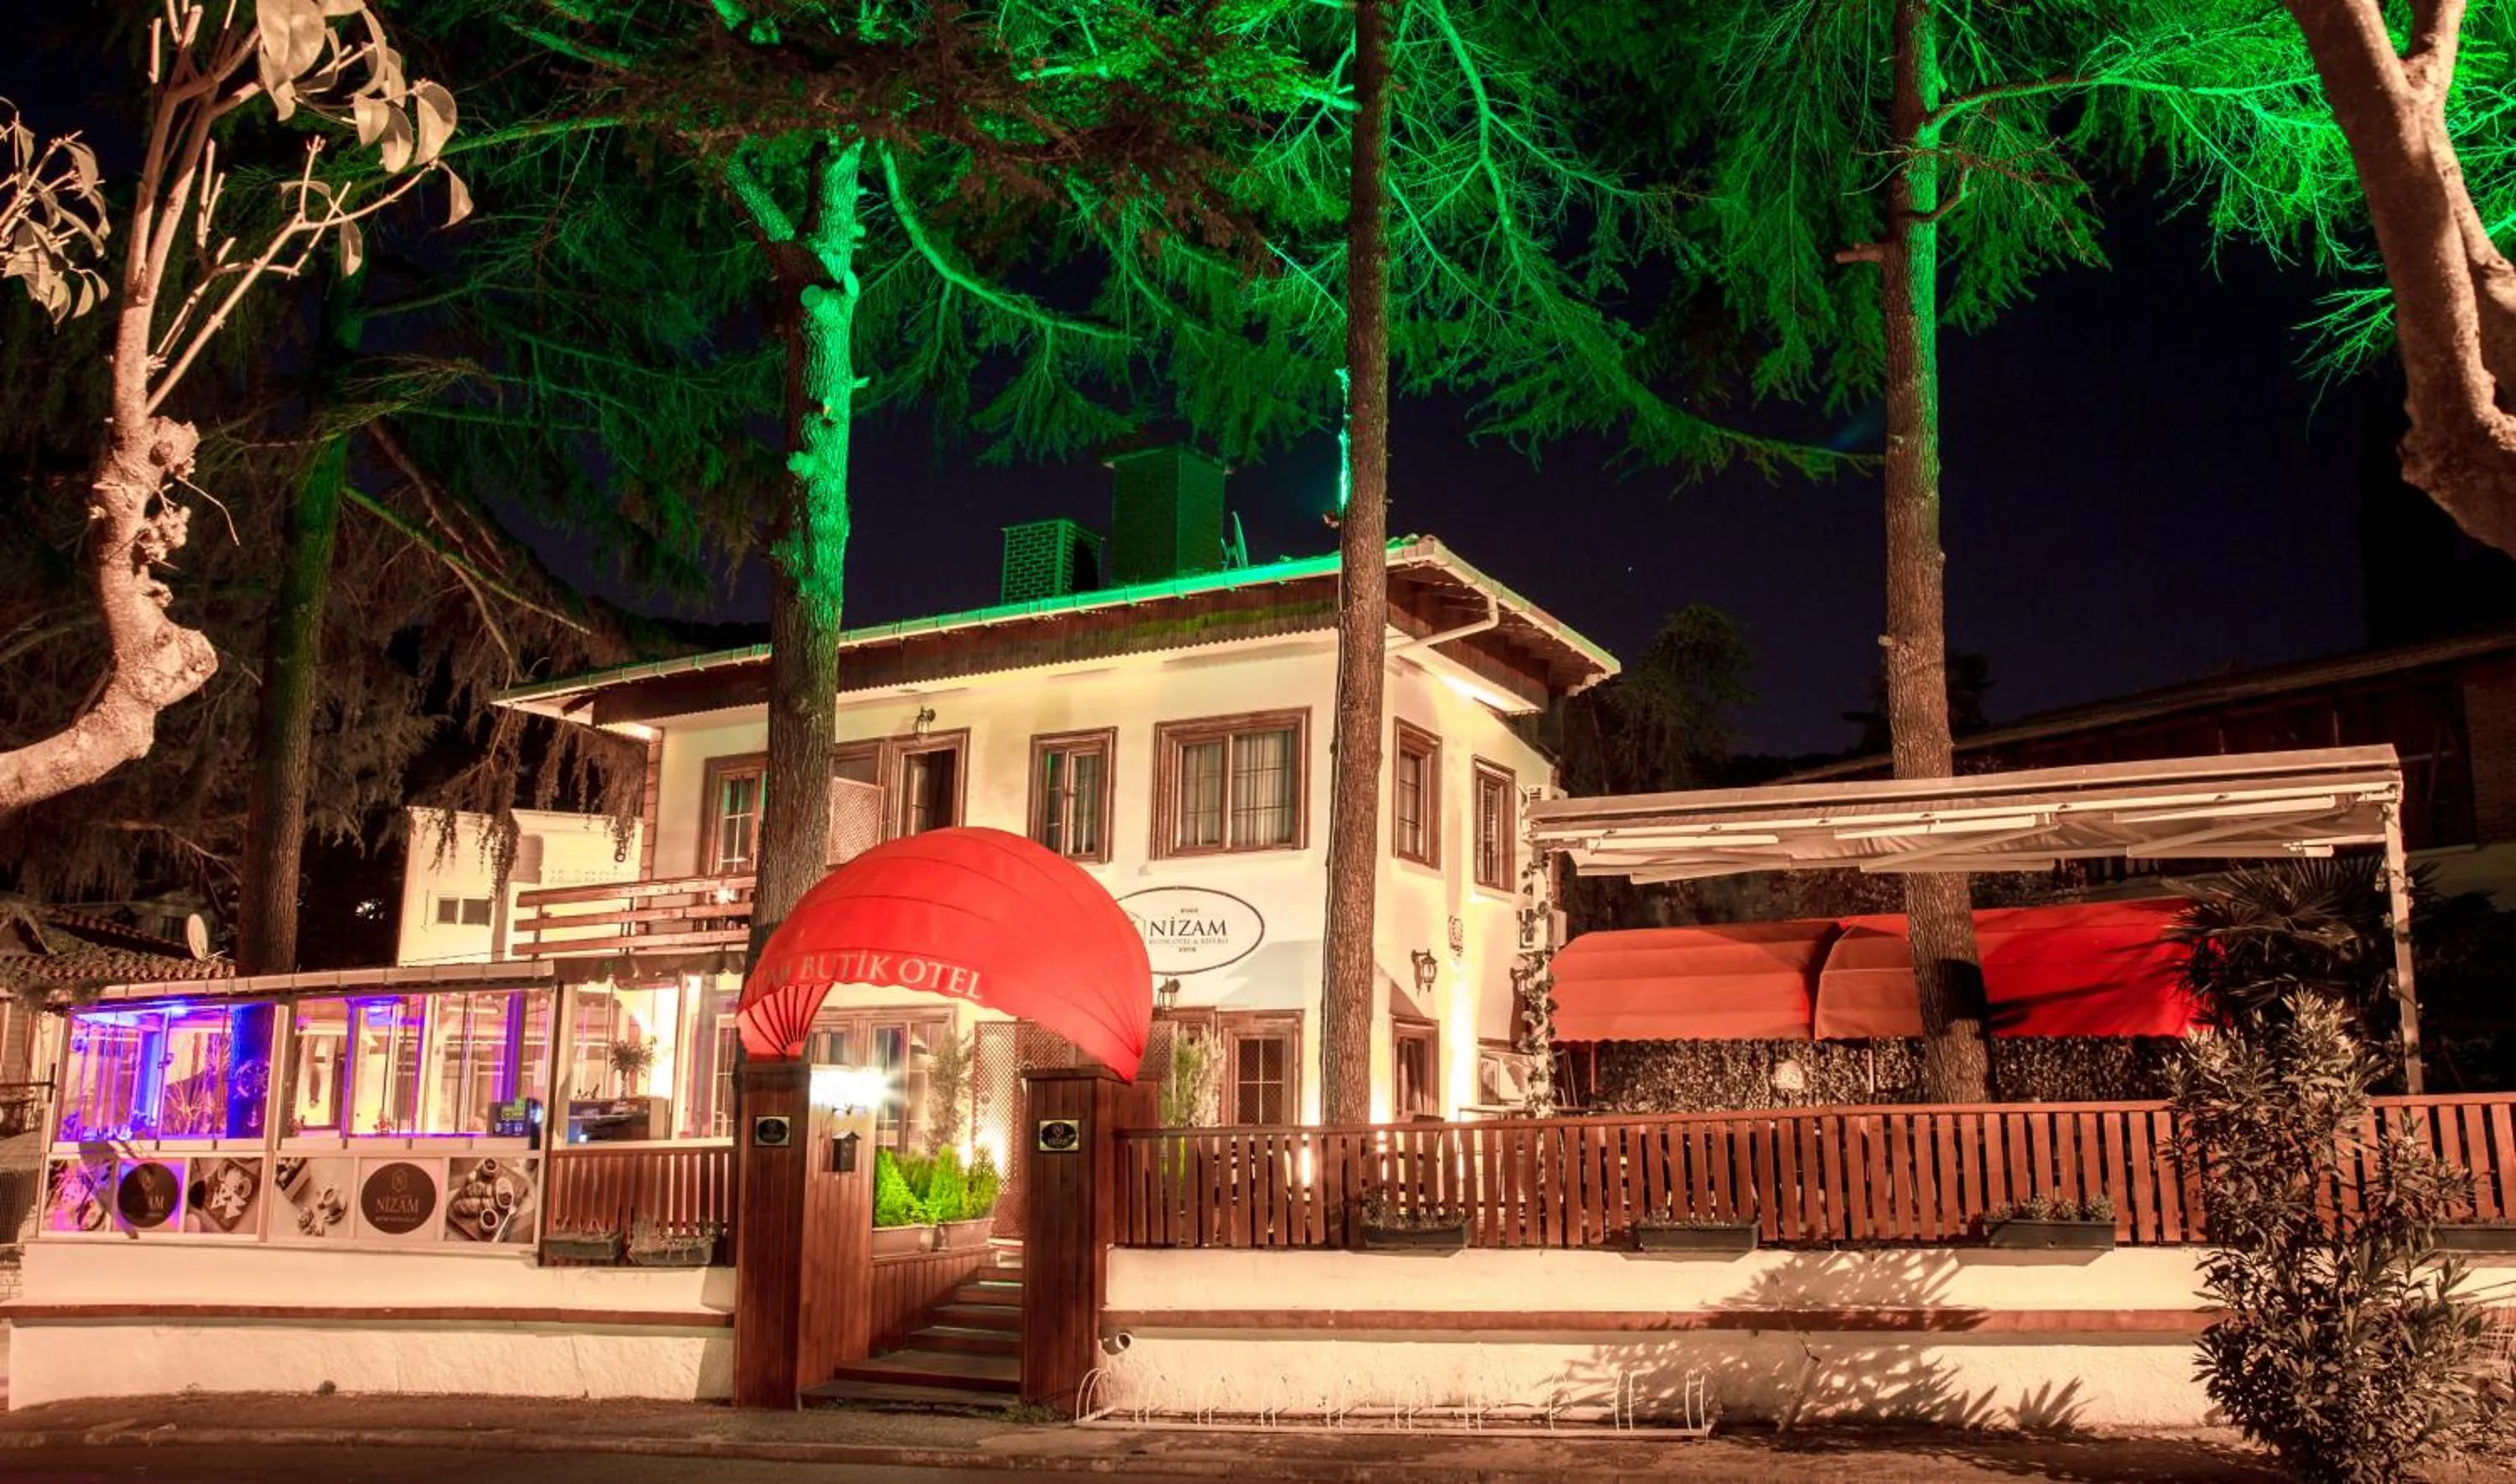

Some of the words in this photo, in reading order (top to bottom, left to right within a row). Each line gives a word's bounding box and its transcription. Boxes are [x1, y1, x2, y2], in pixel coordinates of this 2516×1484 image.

[1150, 916, 1227, 937] NİZAM
[798, 950, 892, 981] BUTİK
[897, 958, 984, 999] OTEL
